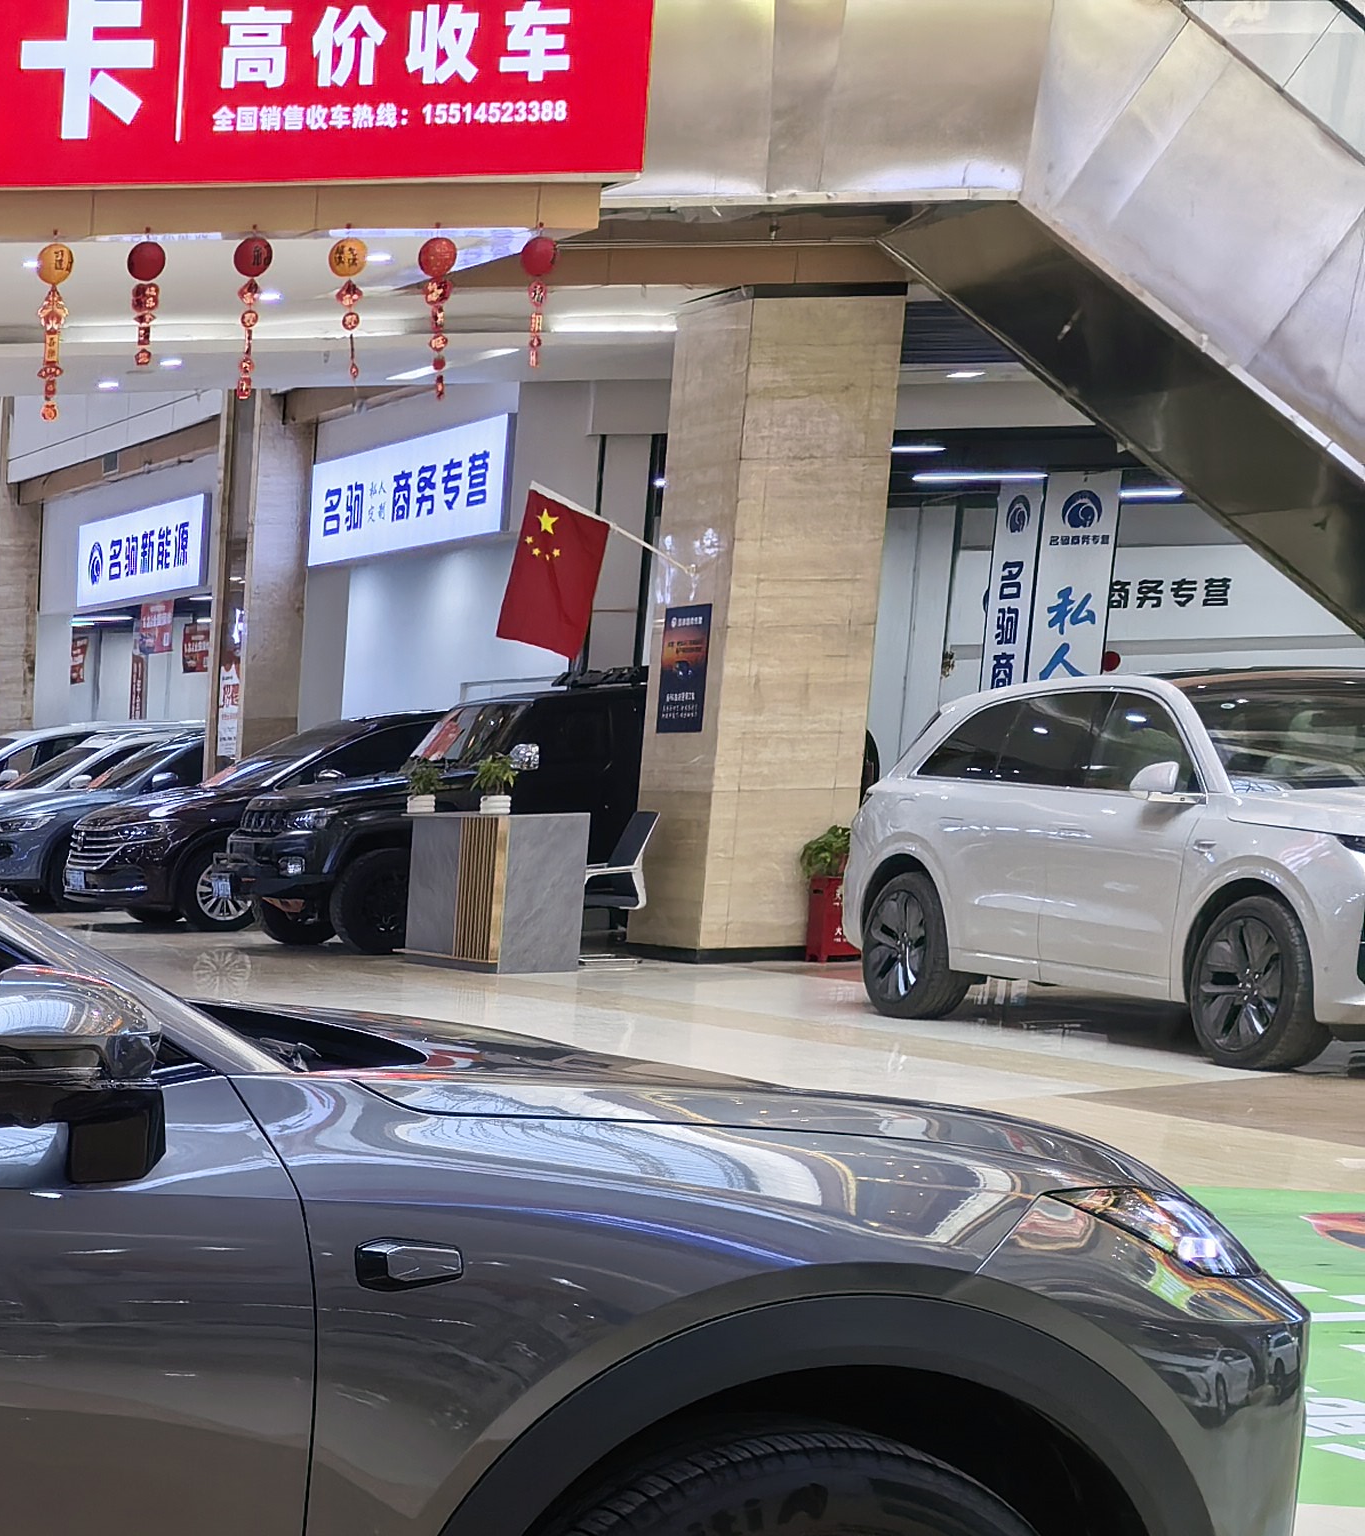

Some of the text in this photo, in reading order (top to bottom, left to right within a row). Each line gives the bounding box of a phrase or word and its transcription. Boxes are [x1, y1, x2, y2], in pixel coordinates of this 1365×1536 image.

[219, 1, 571, 90] 高价收车
[322, 449, 491, 537] 名驹 商务专营
[108, 521, 190, 581] 名驹新能源
[1049, 534, 1110, 546] 名驹商务专营
[1038, 586, 1097, 681] 私人
